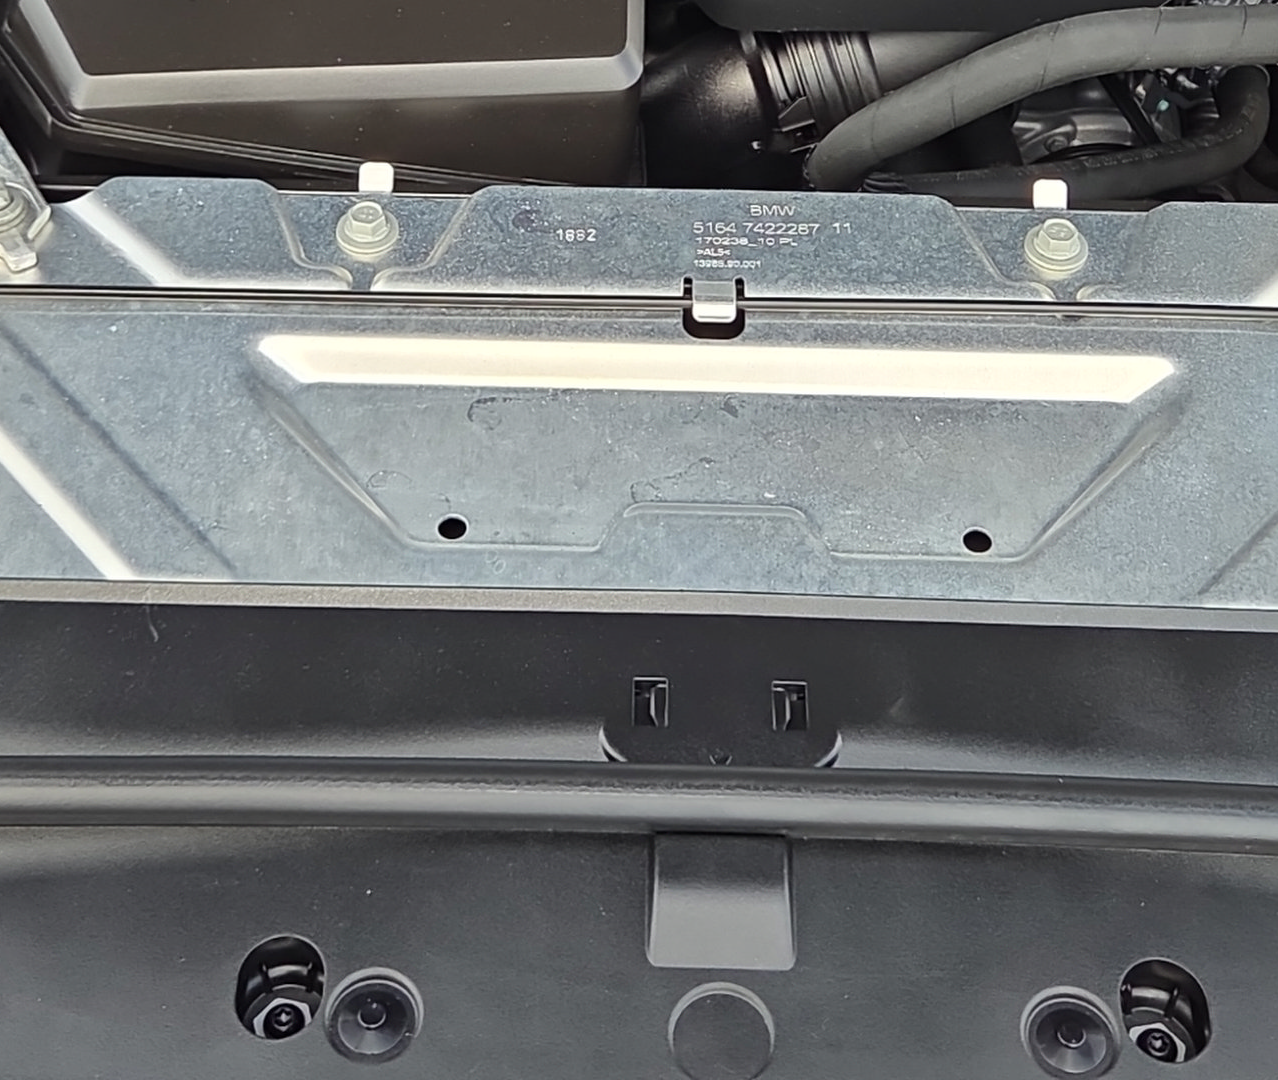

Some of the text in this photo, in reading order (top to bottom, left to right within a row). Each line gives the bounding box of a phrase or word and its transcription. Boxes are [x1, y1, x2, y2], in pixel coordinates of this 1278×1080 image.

[750, 204, 796, 217] BMW
[692, 221, 853, 235] 5164 7422287 11
